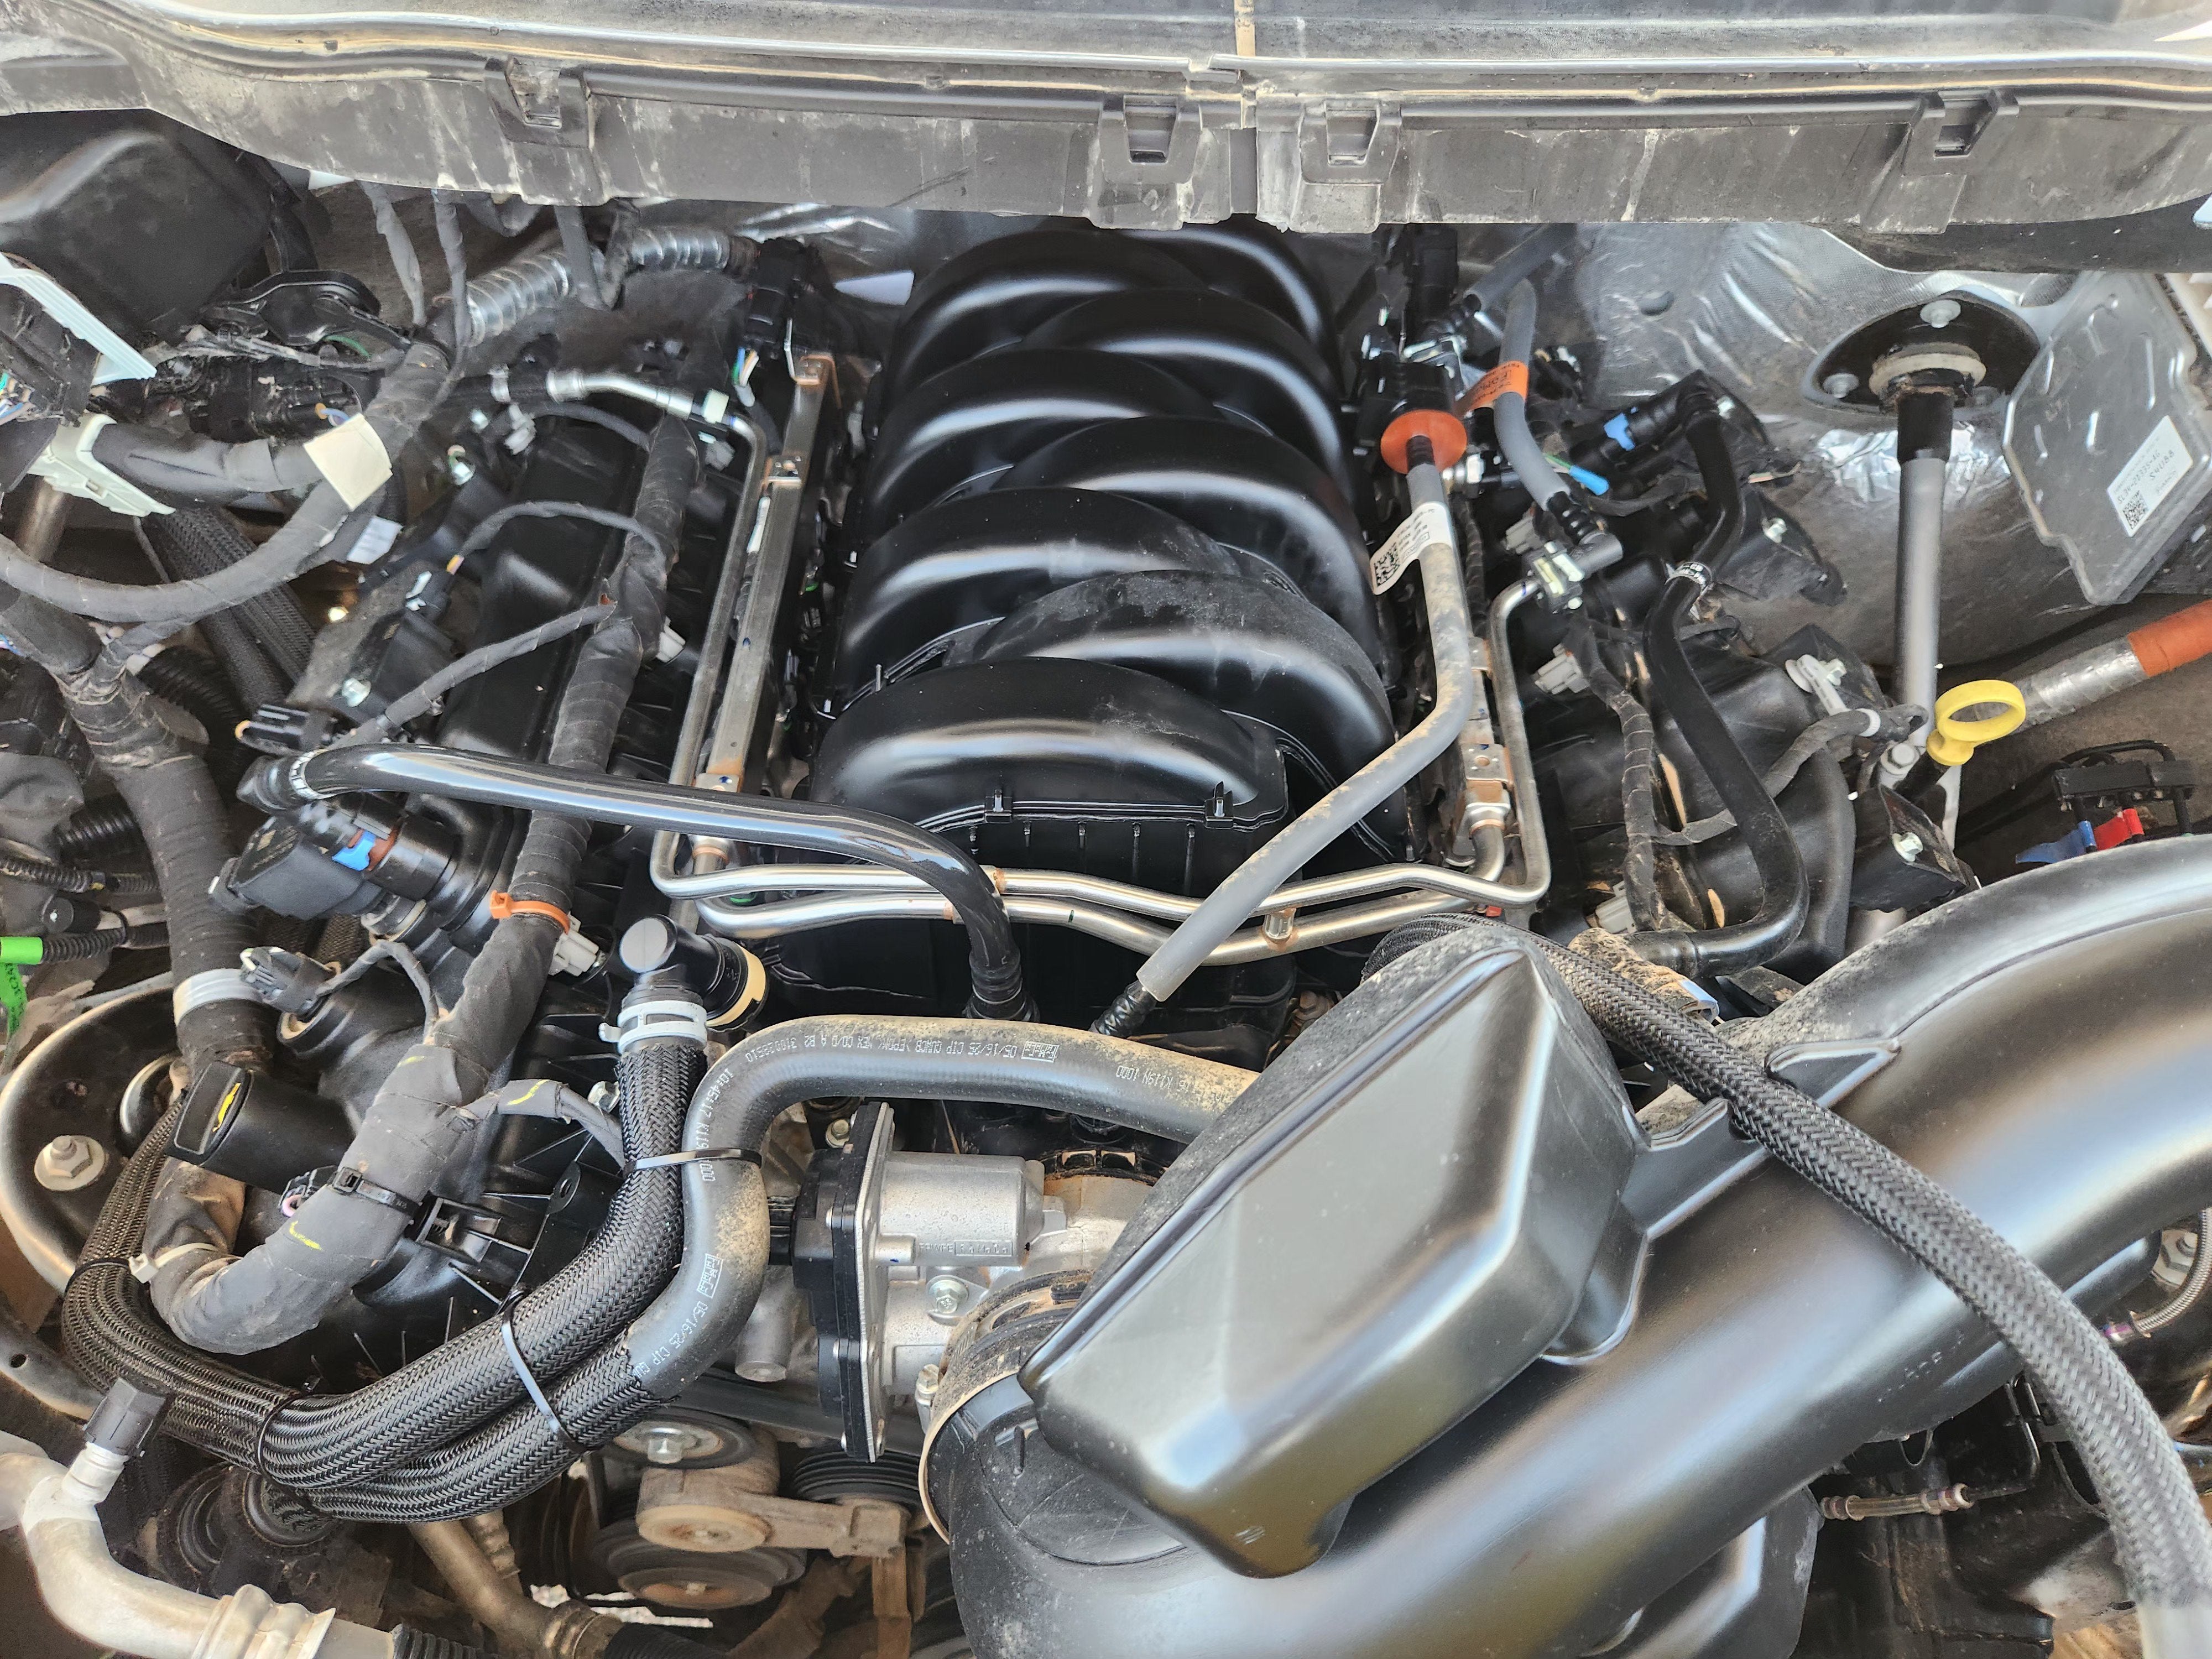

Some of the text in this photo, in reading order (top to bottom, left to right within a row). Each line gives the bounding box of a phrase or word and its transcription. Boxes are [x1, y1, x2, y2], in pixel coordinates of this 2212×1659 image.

[821, 1035, 827, 1047] A
[968, 1042, 1018, 1058] 05/16/25
[1116, 1065, 1140, 1082] 1000
[700, 1068, 734, 1118] 10:45:17
[696, 1122, 709, 1149] K119
[669, 1301, 708, 1349] 05/16/25
